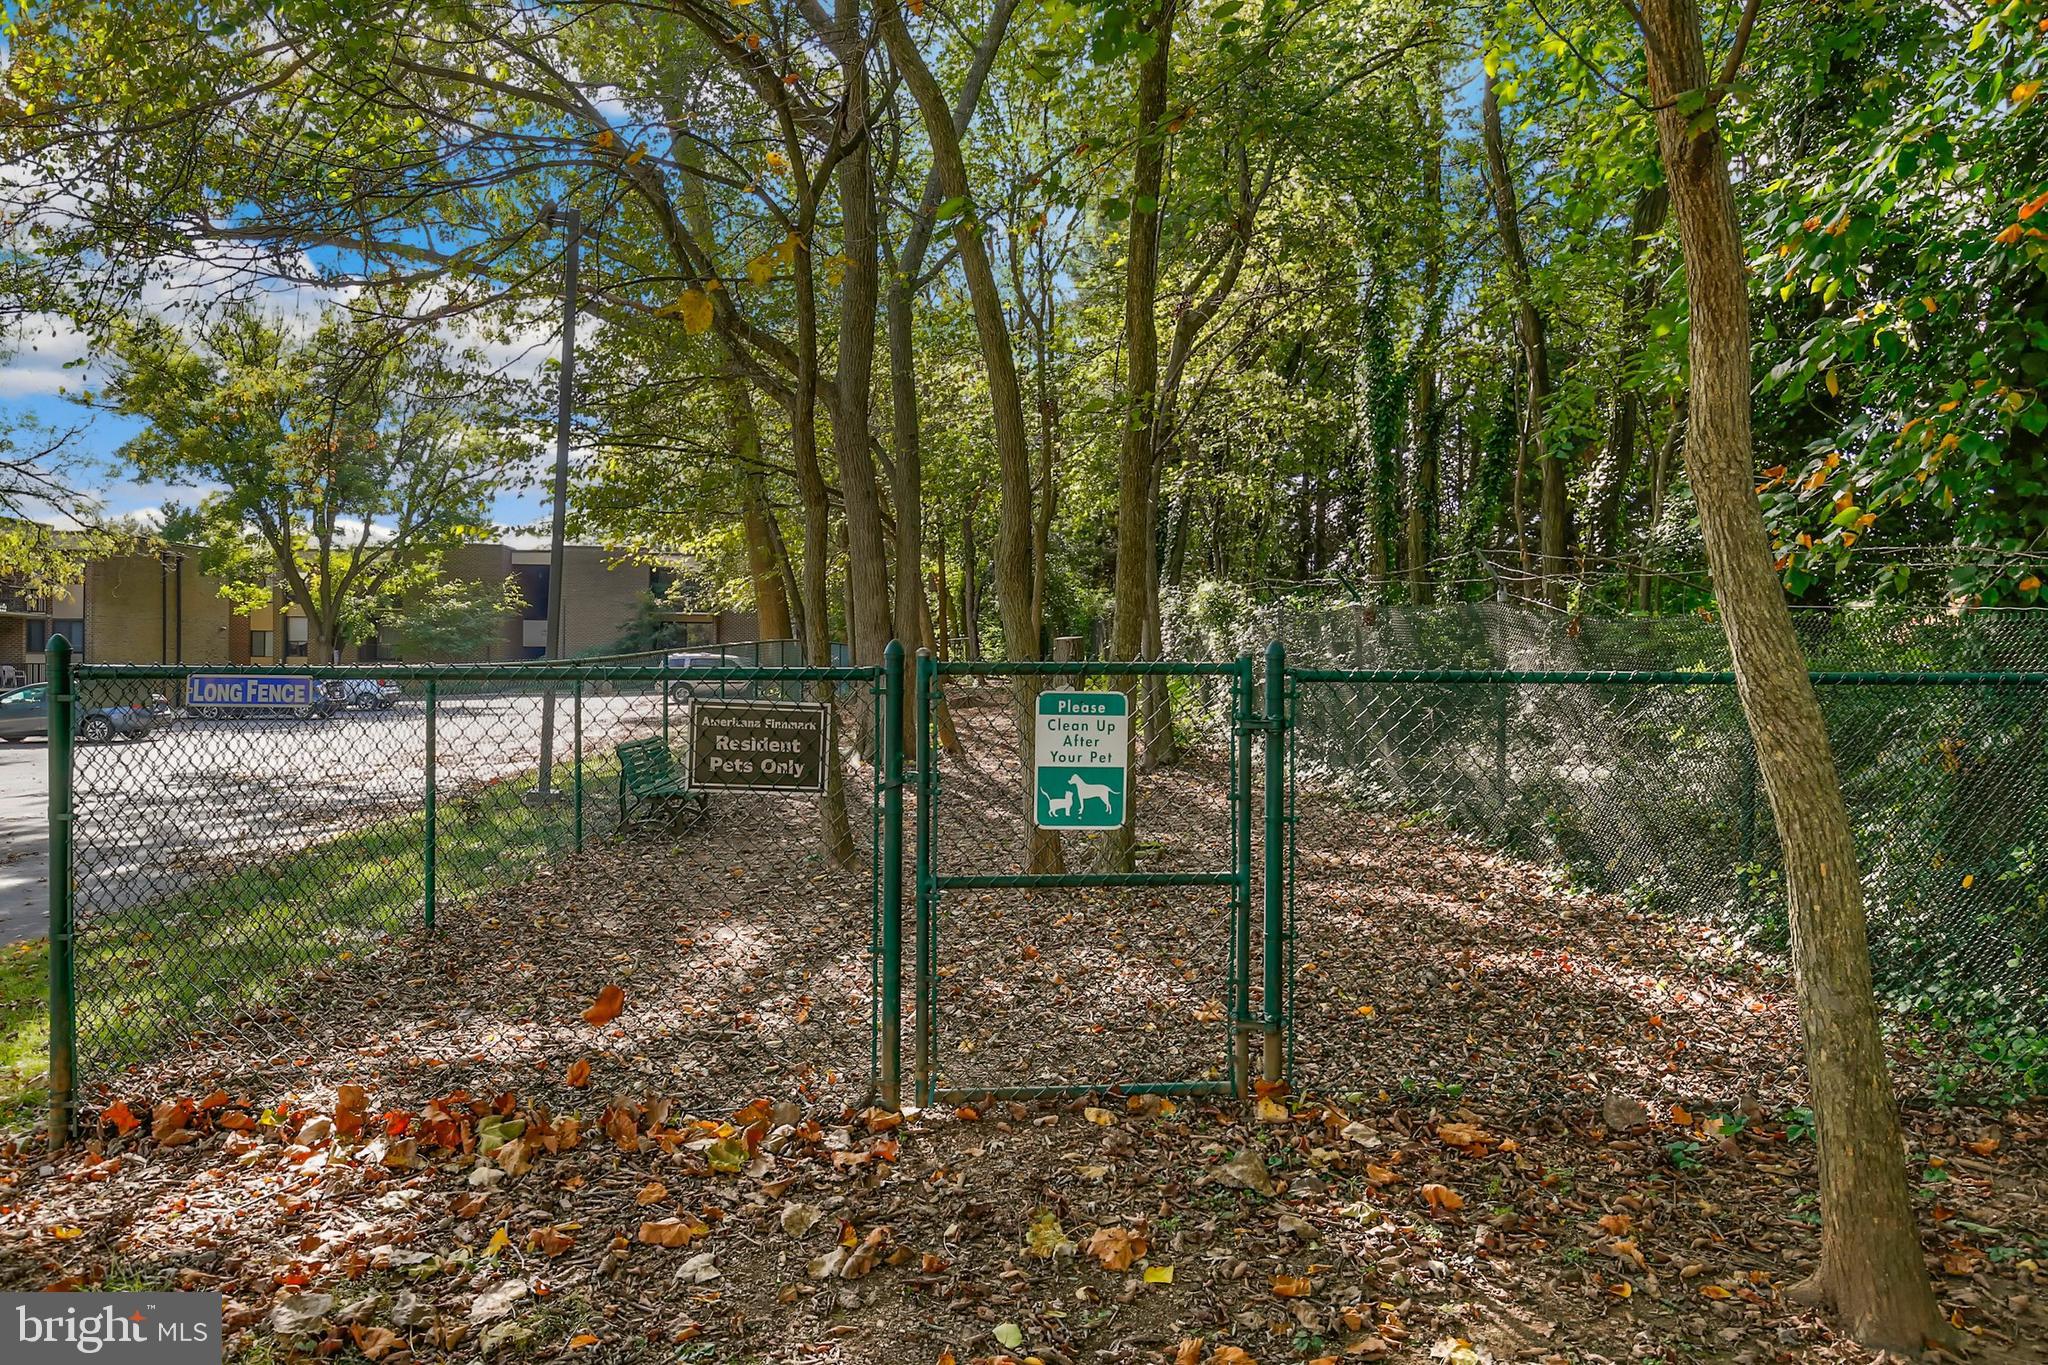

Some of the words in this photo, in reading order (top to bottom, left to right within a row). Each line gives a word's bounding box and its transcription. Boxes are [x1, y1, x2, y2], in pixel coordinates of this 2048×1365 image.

[192, 679, 243, 703] LONG
[246, 679, 306, 703] FENCE
[1058, 699, 1106, 714] Please
[701, 716, 761, 728] Americana
[764, 718, 817, 731] Finnmark
[1047, 718, 1089, 731] Clean
[1096, 719, 1116, 736] Up
[715, 735, 801, 753] Resident
[1062, 733, 1100, 748] After
[1050, 750, 1083, 763] Your
[1089, 751, 1113, 764] Pet
[709, 756, 754, 774] Pets
[760, 758, 805, 778] Only
